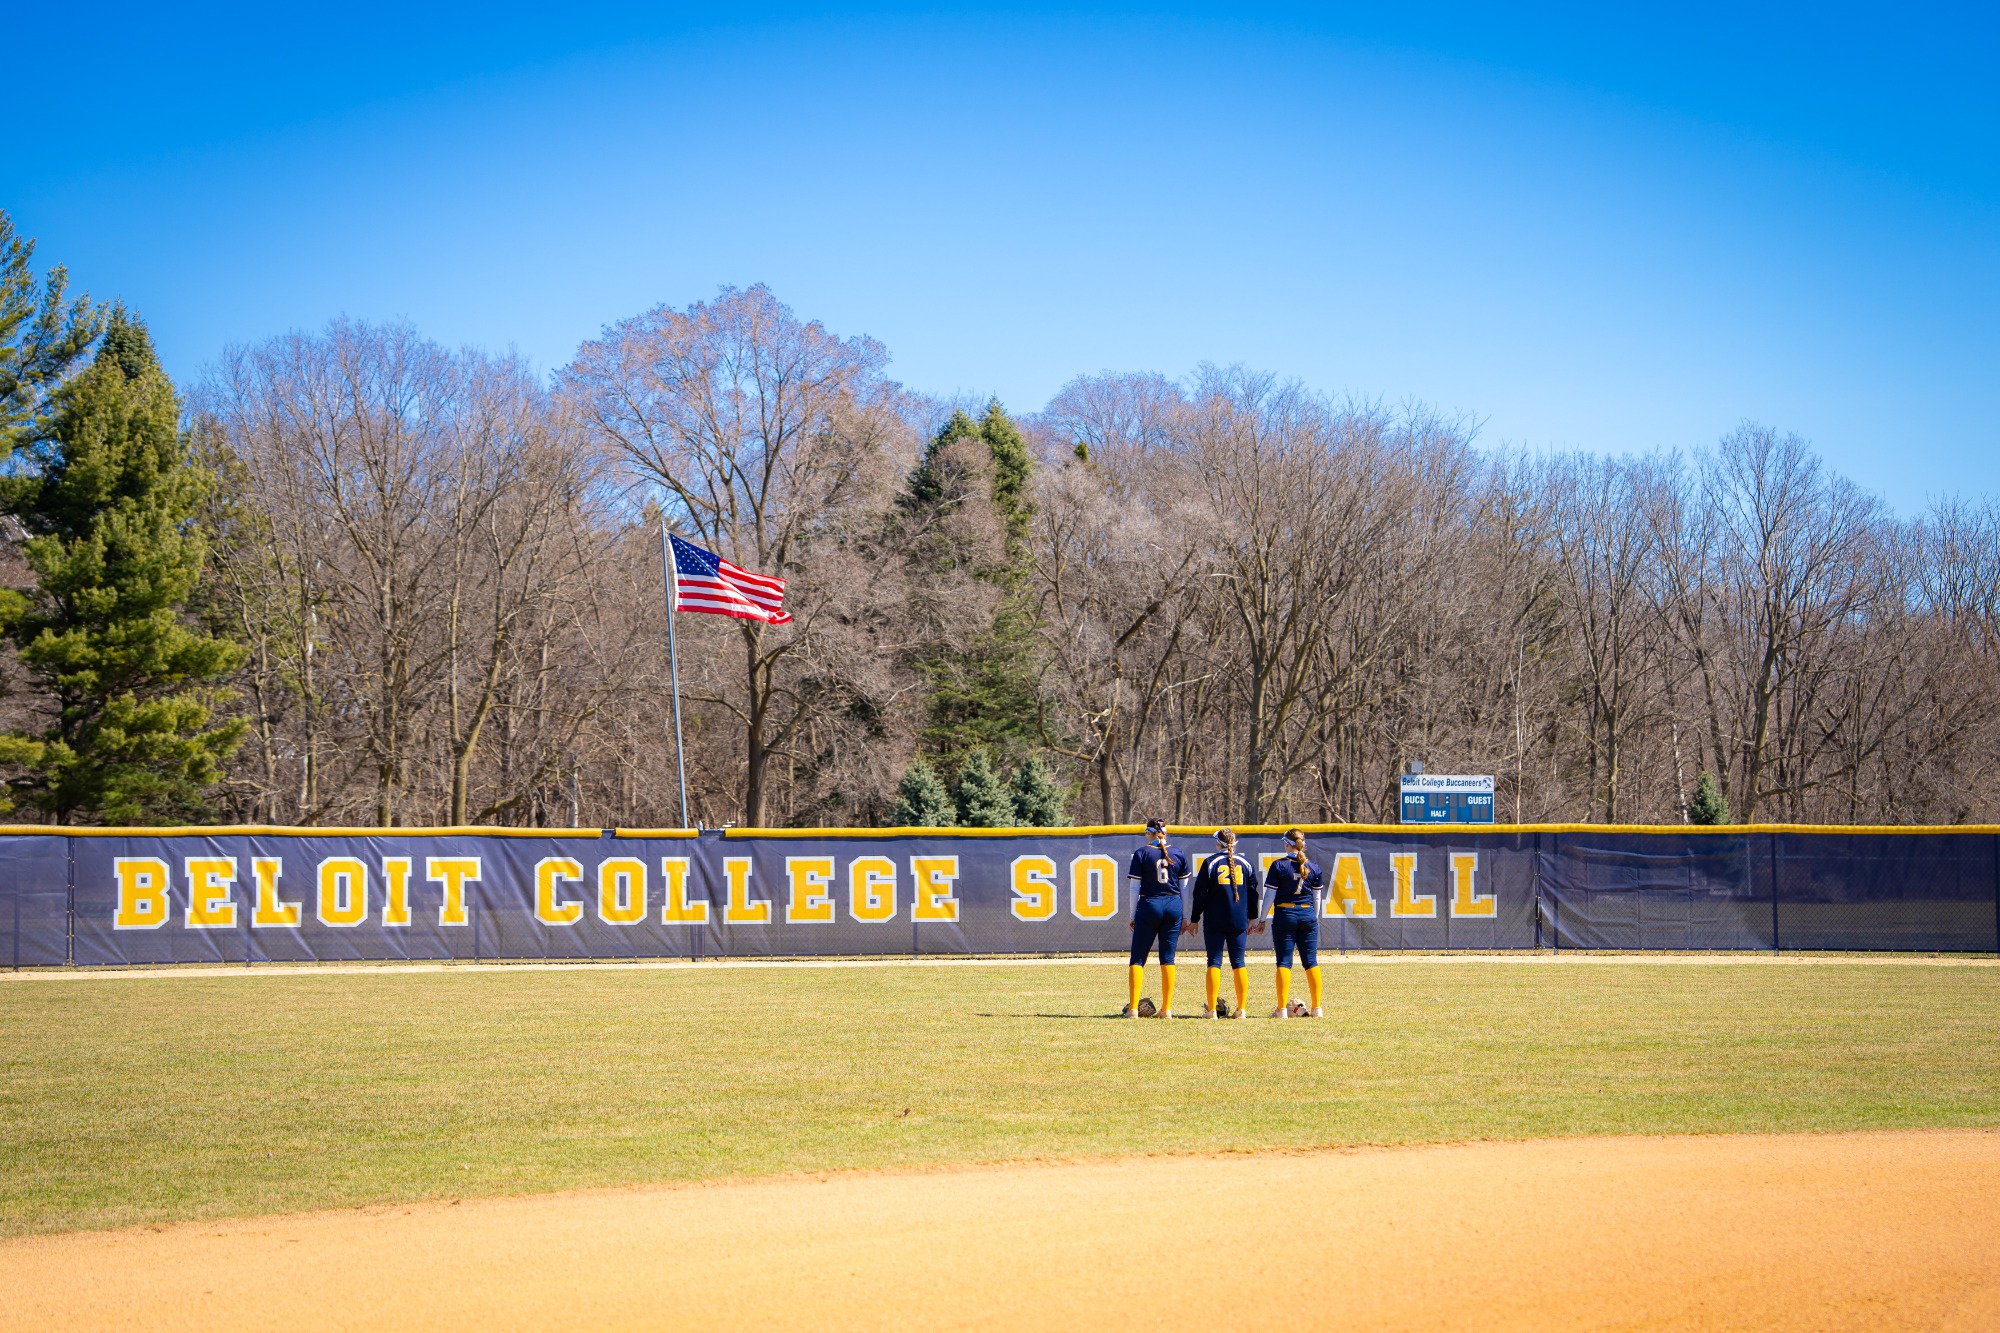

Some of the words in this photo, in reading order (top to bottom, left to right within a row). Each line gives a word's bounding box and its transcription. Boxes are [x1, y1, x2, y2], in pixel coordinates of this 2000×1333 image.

[1402, 778, 1420, 786] Beloit
[1422, 778, 1445, 788] College
[1446, 778, 1482, 787] Buccaneers
[1404, 796, 1424, 804] BUCS
[1468, 796, 1492, 804] GUEST
[1156, 859, 1169, 884] 6
[1217, 865, 1244, 885] 24
[113, 856, 481, 931] BELOIT
[534, 856, 960, 926] COLLEGE
[1010, 852, 1498, 922] SOALL
[1293, 873, 1304, 895] 7
